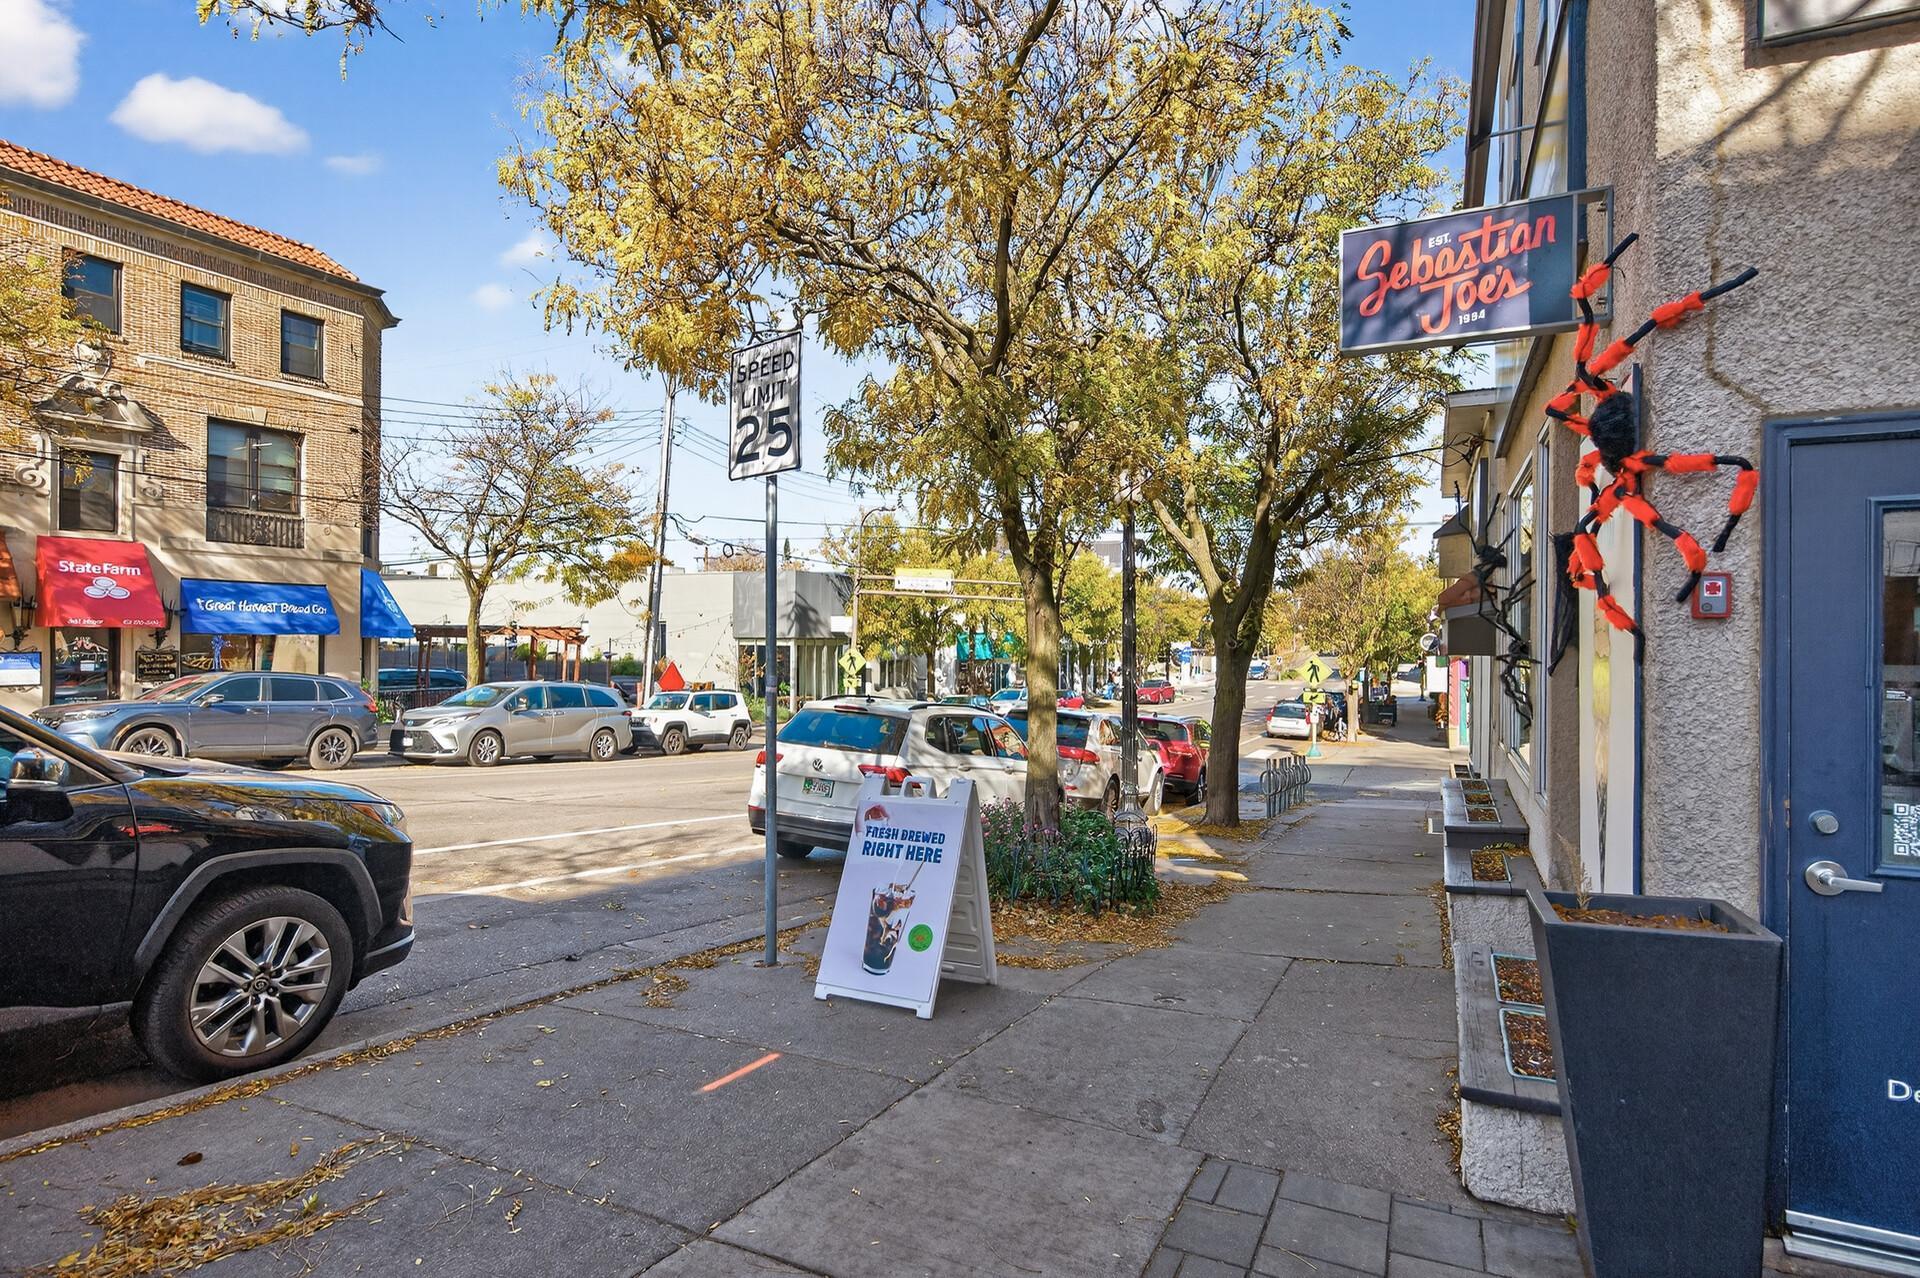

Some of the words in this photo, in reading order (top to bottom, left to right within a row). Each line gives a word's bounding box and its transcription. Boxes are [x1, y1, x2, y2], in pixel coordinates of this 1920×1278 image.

[1428, 232, 1452, 249] EST.
[1357, 214, 1556, 317] Sebastian
[1419, 264, 1533, 334] Joe's
[1458, 309, 1486, 325] 1984
[736, 351, 795, 383] SPEED
[741, 378, 787, 410] LIMIT
[736, 406, 793, 464] 25
[865, 825, 899, 840] FRESH
[901, 829, 945, 844] BREWED
[862, 840, 904, 859] RIGHT
[905, 844, 943, 863] HERE
